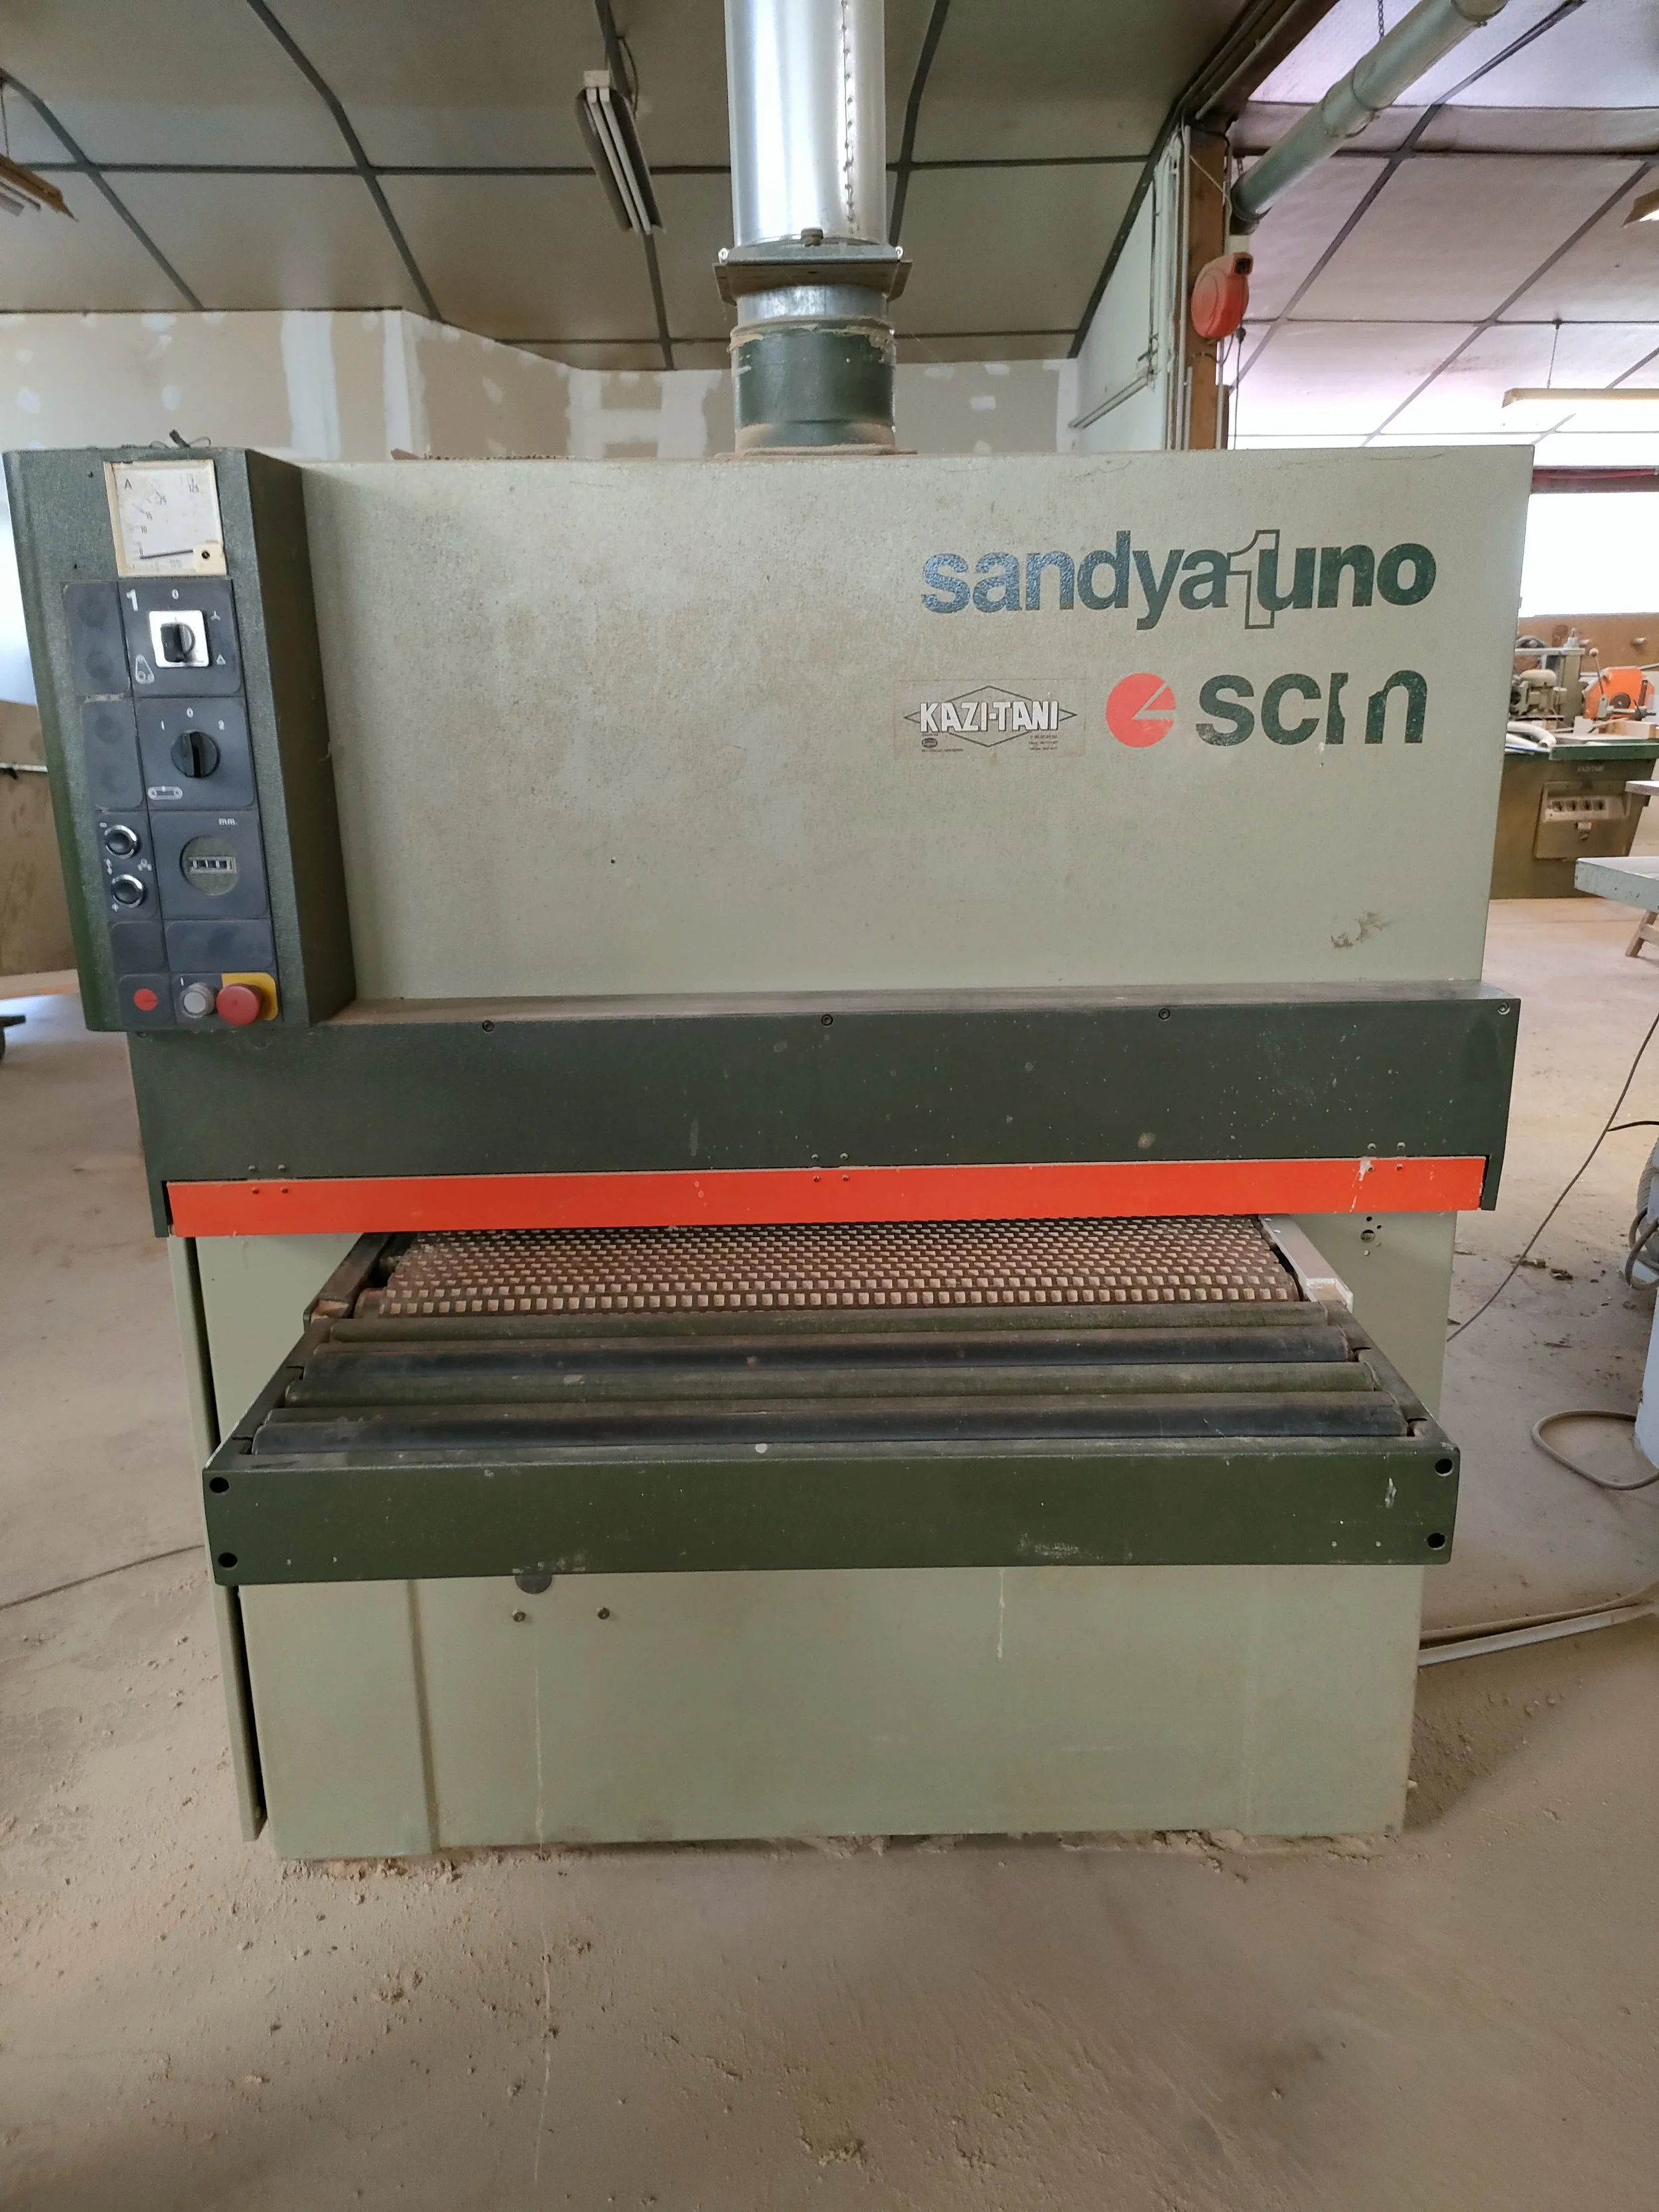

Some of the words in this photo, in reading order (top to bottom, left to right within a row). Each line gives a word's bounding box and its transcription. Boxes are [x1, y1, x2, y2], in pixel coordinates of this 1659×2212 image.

[124, 479, 132, 490] A
[171, 589, 179, 600] 0
[126, 589, 139, 612] 1
[186, 707, 194, 718] 0
[920, 701, 1059, 733] KAZI-TANI
